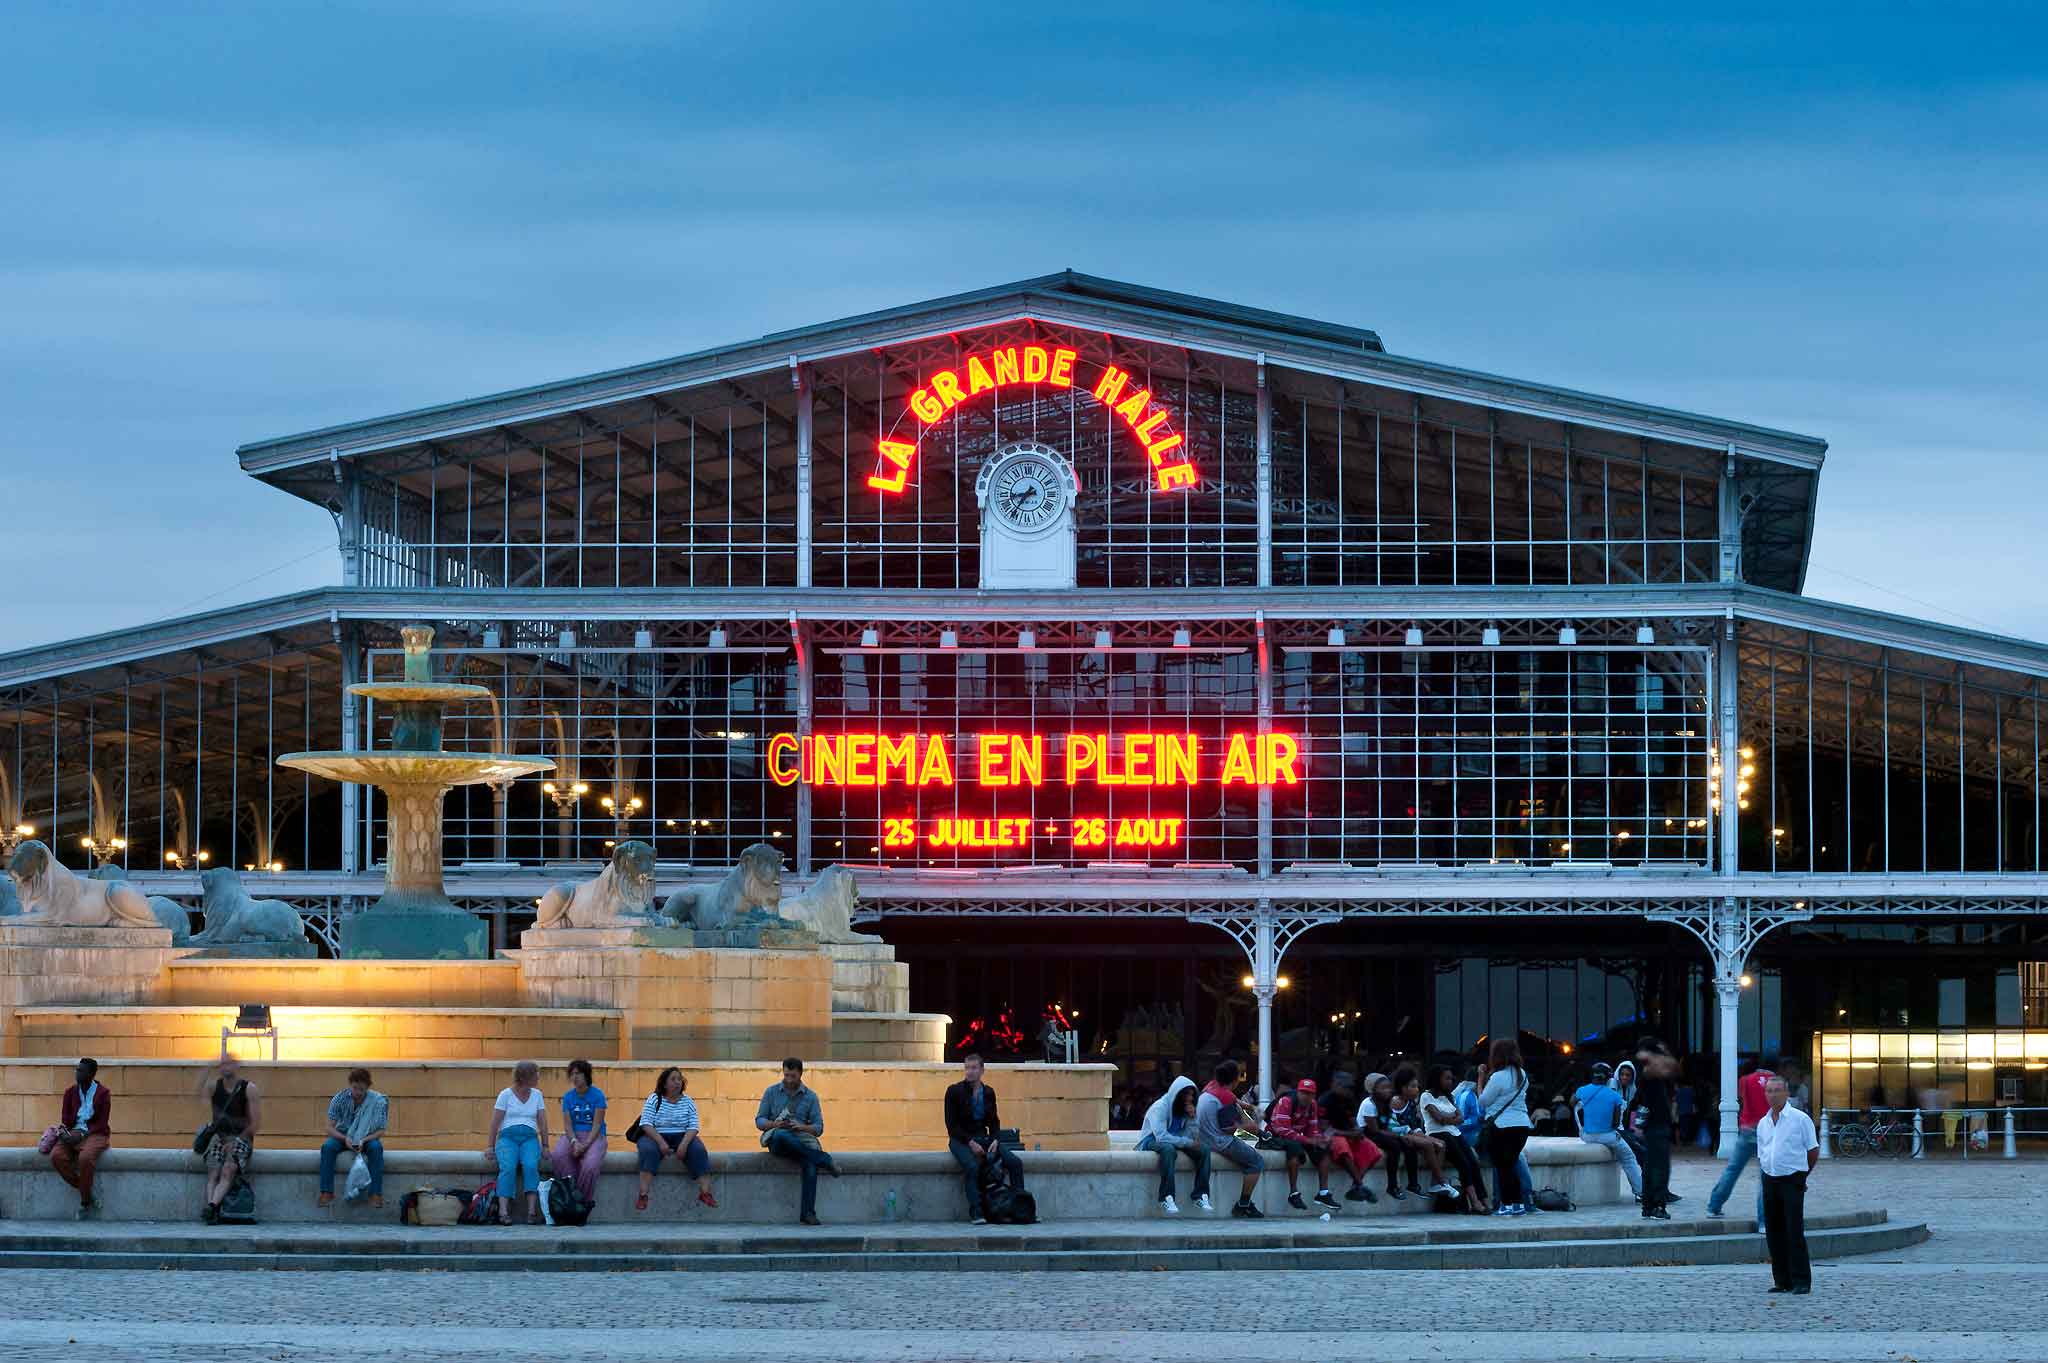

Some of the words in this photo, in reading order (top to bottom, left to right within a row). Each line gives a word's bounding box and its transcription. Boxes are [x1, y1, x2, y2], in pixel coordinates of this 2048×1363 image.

[867, 440, 916, 493] LA
[910, 346, 1077, 424] GRANDE
[1094, 365, 1196, 491] HALLE
[767, 732, 954, 786] CINEMA
[979, 734, 1042, 786] EN
[1066, 733, 1198, 786] PLEIN
[1221, 733, 1298, 785] AIR
[884, 818, 915, 847] 25
[928, 818, 1031, 847] JUILLET
[1073, 818, 1107, 847] 26
[1114, 818, 1182, 847] AOUT
